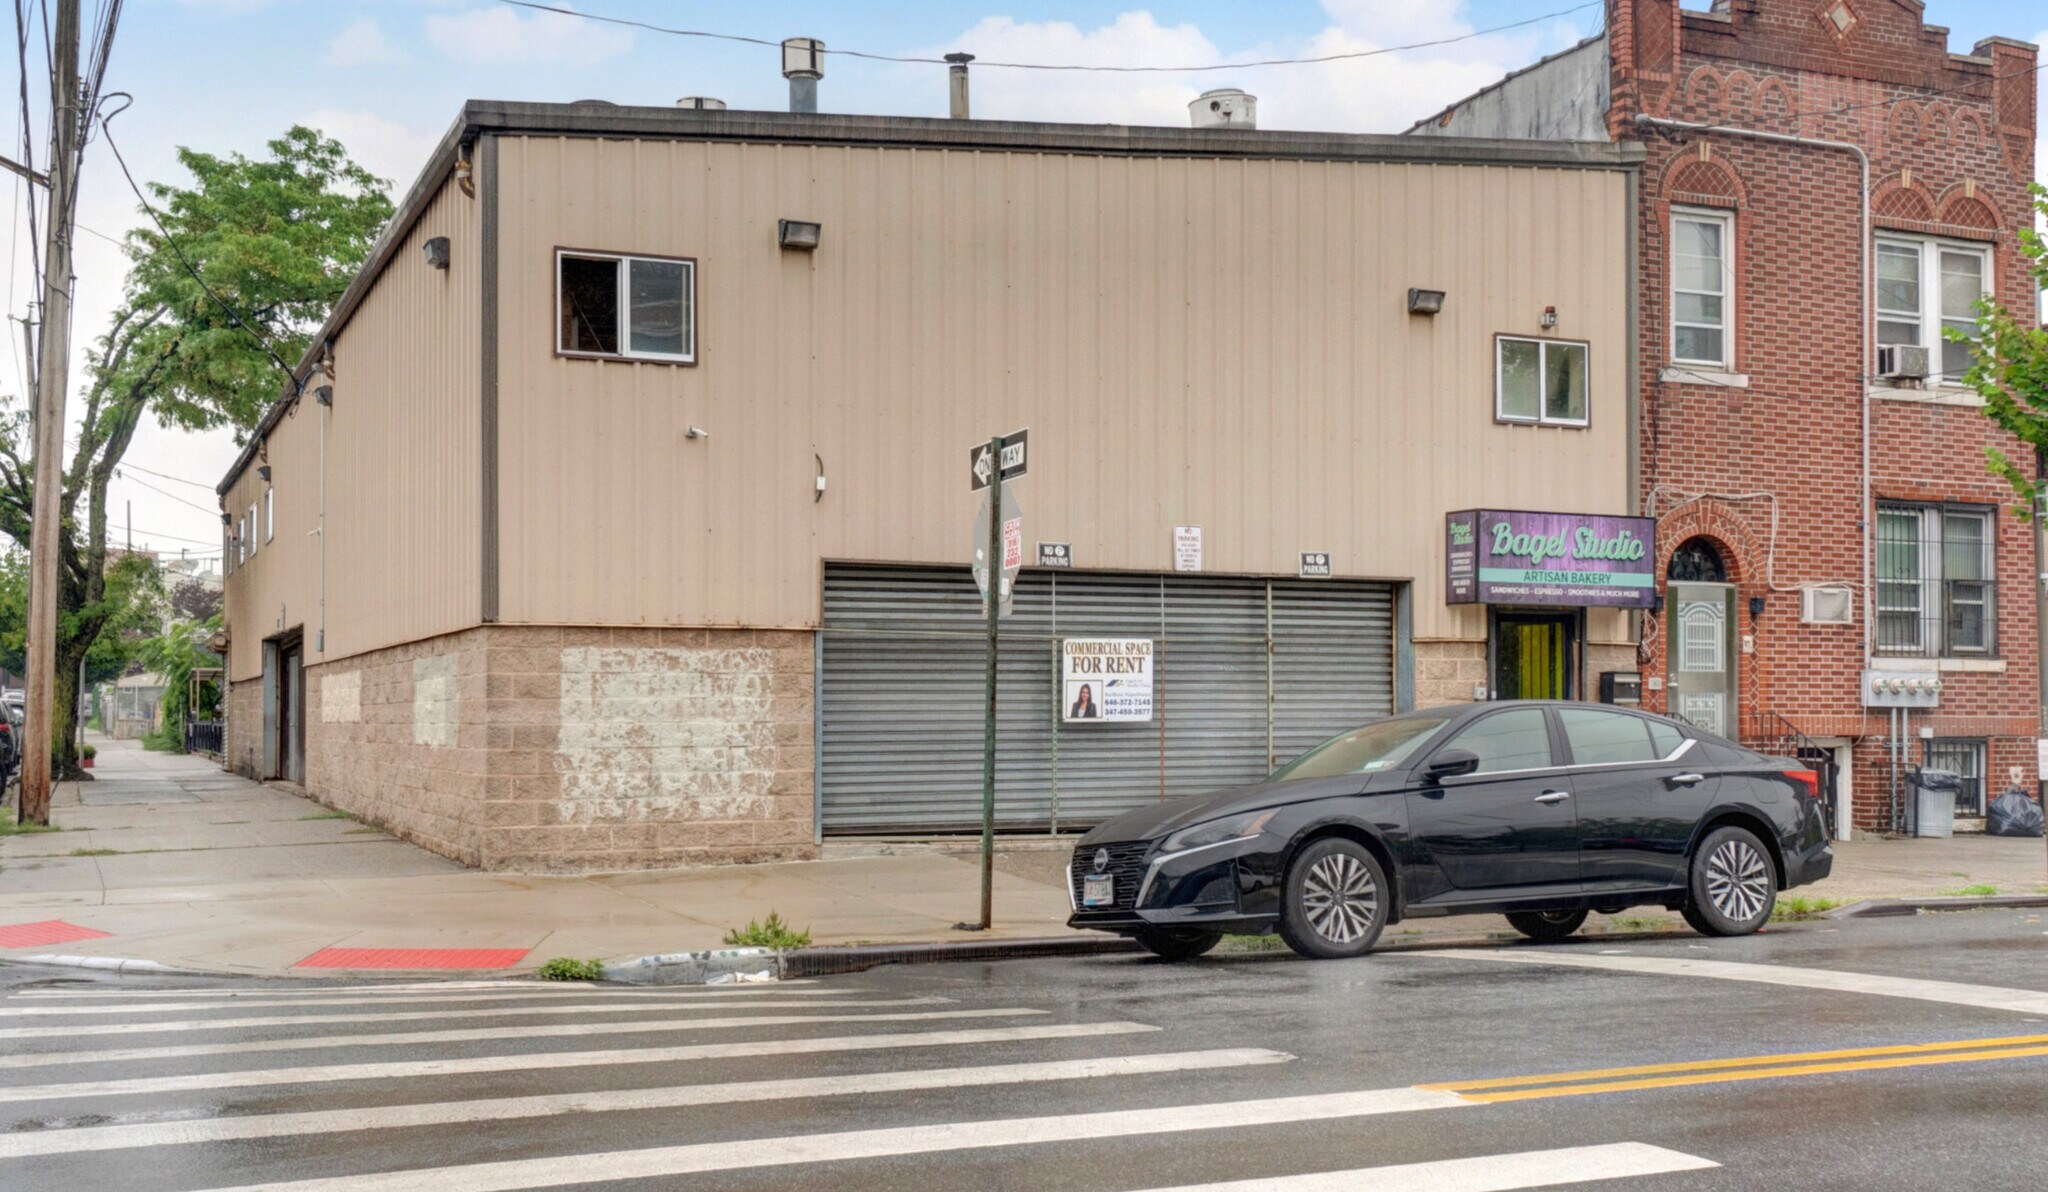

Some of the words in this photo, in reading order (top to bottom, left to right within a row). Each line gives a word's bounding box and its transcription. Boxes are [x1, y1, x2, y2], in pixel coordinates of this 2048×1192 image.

[1001, 445, 1021, 468] WAY
[1044, 545, 1054, 555] NO
[1491, 522, 1568, 565] Bagel
[1572, 526, 1645, 561] Studio
[1041, 556, 1069, 567] PARKING
[1306, 555, 1315, 564] NO
[1303, 565, 1328, 575] PARKING
[1523, 571, 1569, 583] ARTISAN
[1571, 572, 1612, 585] BAKERY
[1491, 586, 1530, 595] SANDWICHES
[1534, 588, 1563, 596] ESPRESSO
[1606, 590, 1623, 598] MUCH
[1623, 591, 1640, 599] MORE
[1065, 642, 1123, 656] COMMERCIAL
[1125, 642, 1152, 656] SPACE
[1071, 656, 1102, 674] FOR
[1105, 656, 1145, 674] RENT
